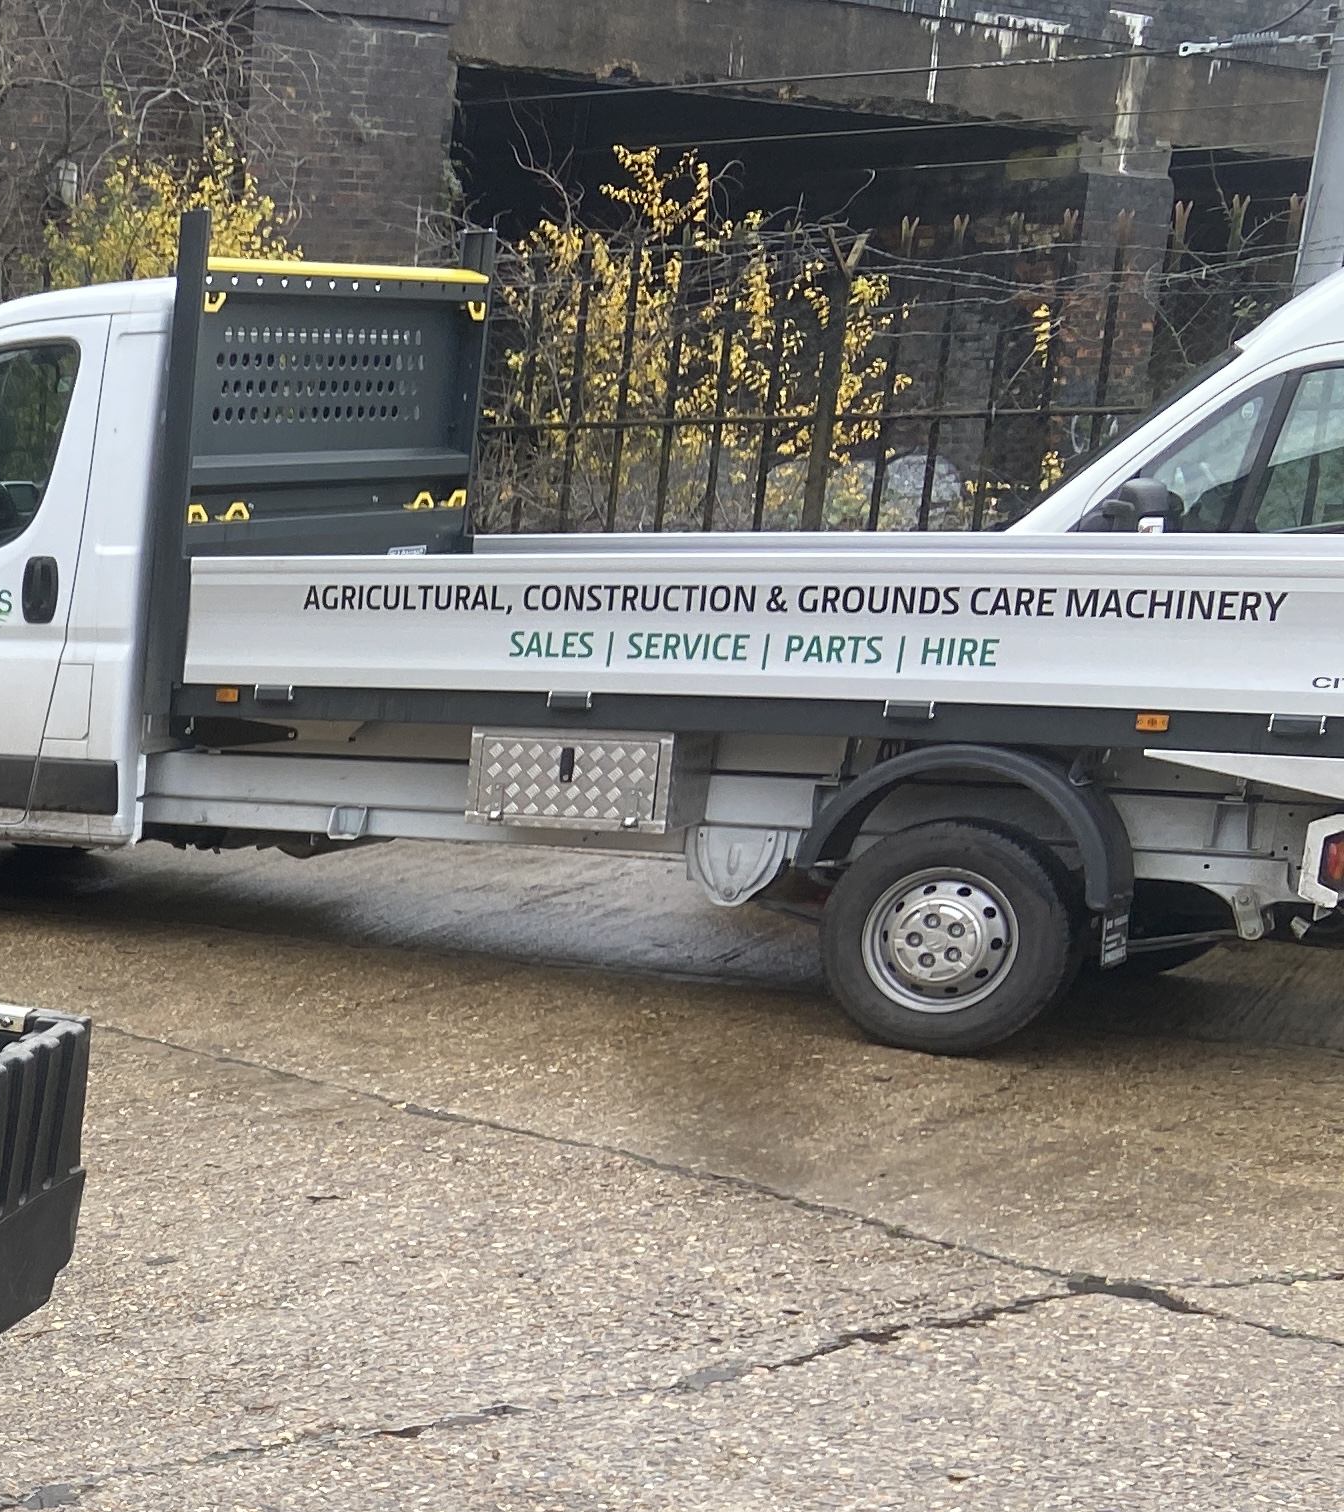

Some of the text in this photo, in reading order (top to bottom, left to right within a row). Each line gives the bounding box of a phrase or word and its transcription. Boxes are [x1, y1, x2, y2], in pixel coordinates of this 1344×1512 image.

[303, 584, 1289, 622] AGRICULTURAL, CONSTRUCTION & GROUNDS CARE MACHINERY
[508, 630, 595, 659] SALES
[626, 631, 751, 662] SERVICE
[784, 634, 884, 665] PARTS
[920, 636, 1001, 667] HIRE
[1312, 676, 1344, 689] CI
